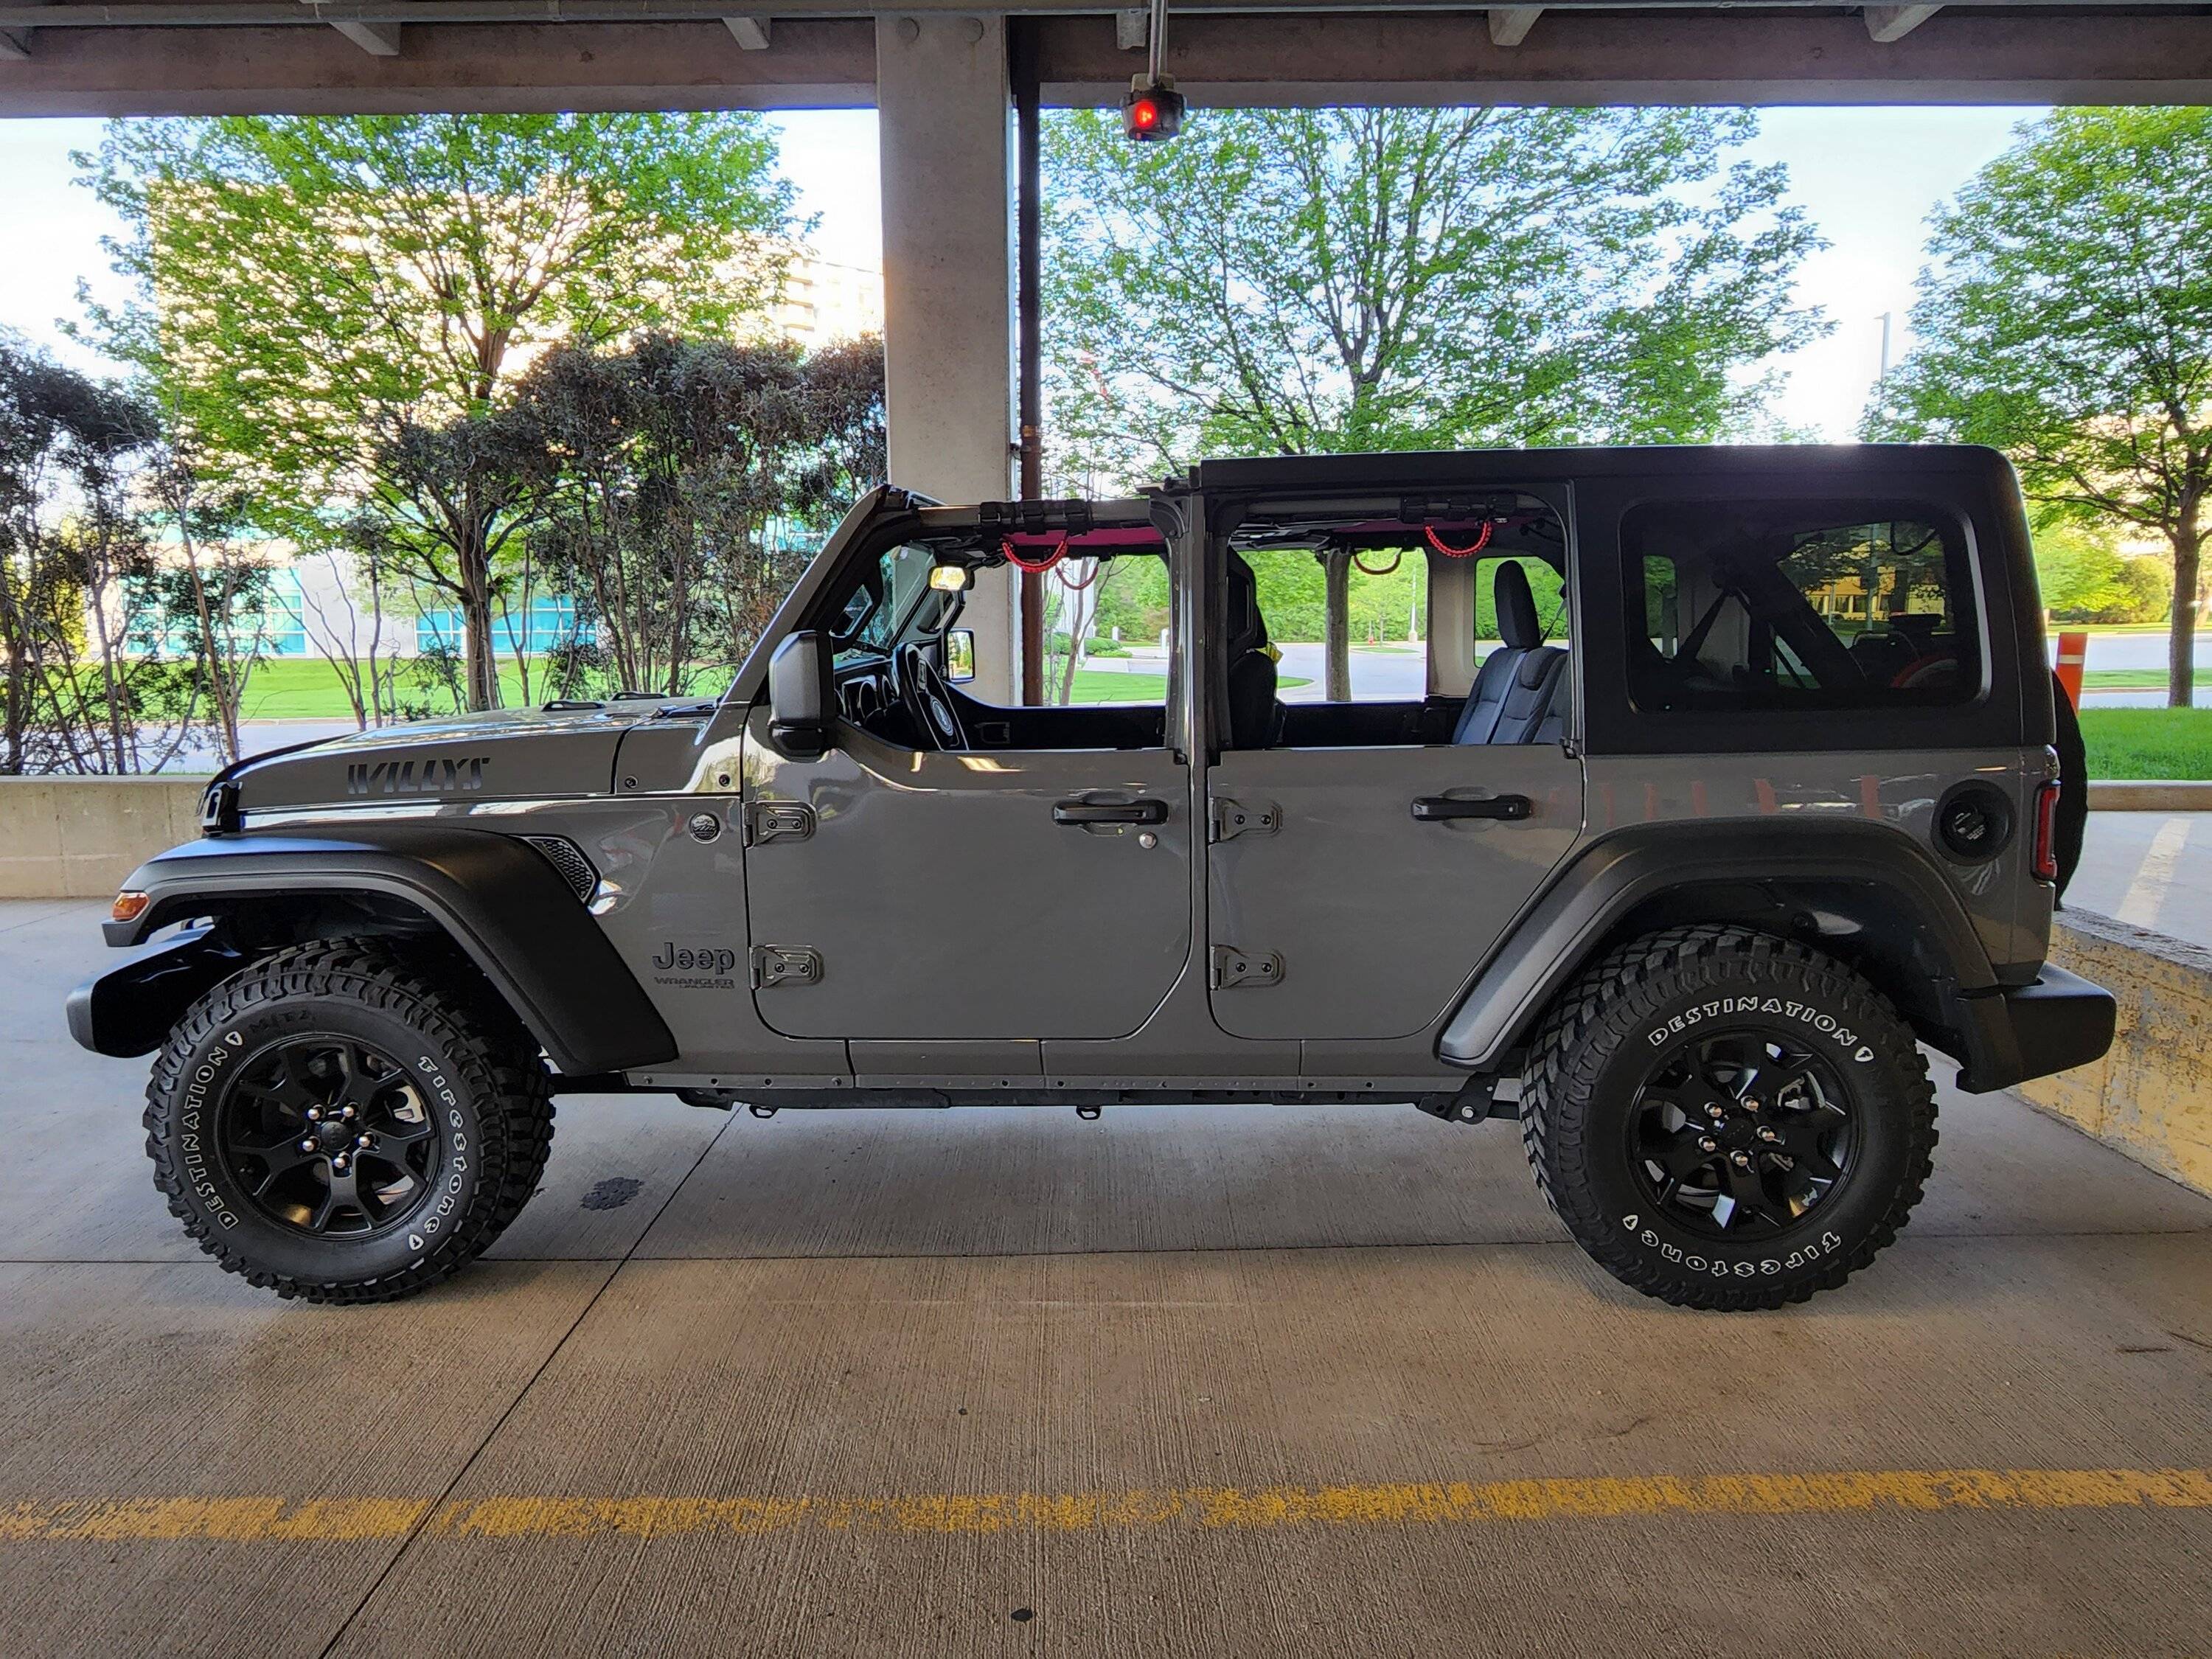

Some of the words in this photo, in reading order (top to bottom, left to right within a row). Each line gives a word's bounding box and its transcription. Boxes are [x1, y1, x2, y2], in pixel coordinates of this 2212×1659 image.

[348, 757, 490, 794] WILLYS
[652, 942, 735, 975] Jeep
[653, 977, 734, 985] WRANGLER
[1647, 996, 1858, 1046] DESTINATION
[181, 1046, 239, 1230] DESTINATION
